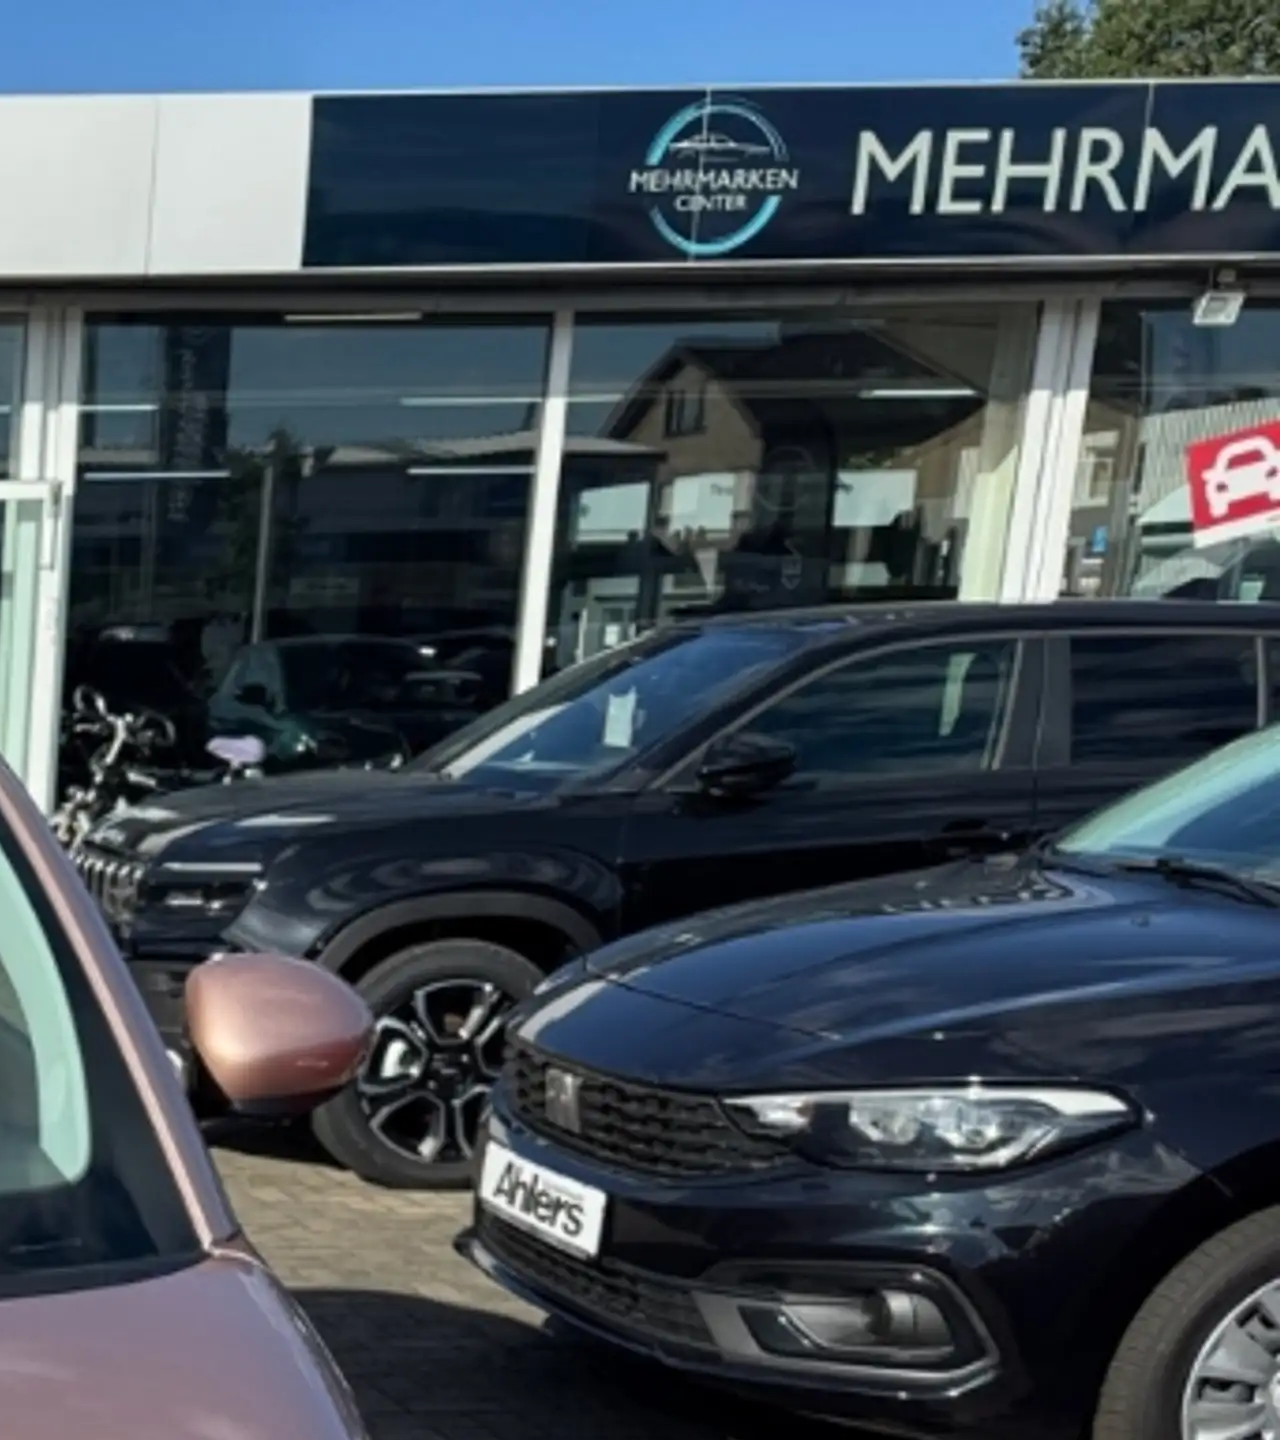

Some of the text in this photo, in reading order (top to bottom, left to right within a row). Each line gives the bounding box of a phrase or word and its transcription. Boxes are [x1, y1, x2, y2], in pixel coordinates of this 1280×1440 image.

[627, 168, 800, 193] MEHRMARKEN
[849, 123, 1280, 216] MEHRMA
[673, 194, 749, 212] CENTER
[492, 1161, 584, 1238] Ahlers
